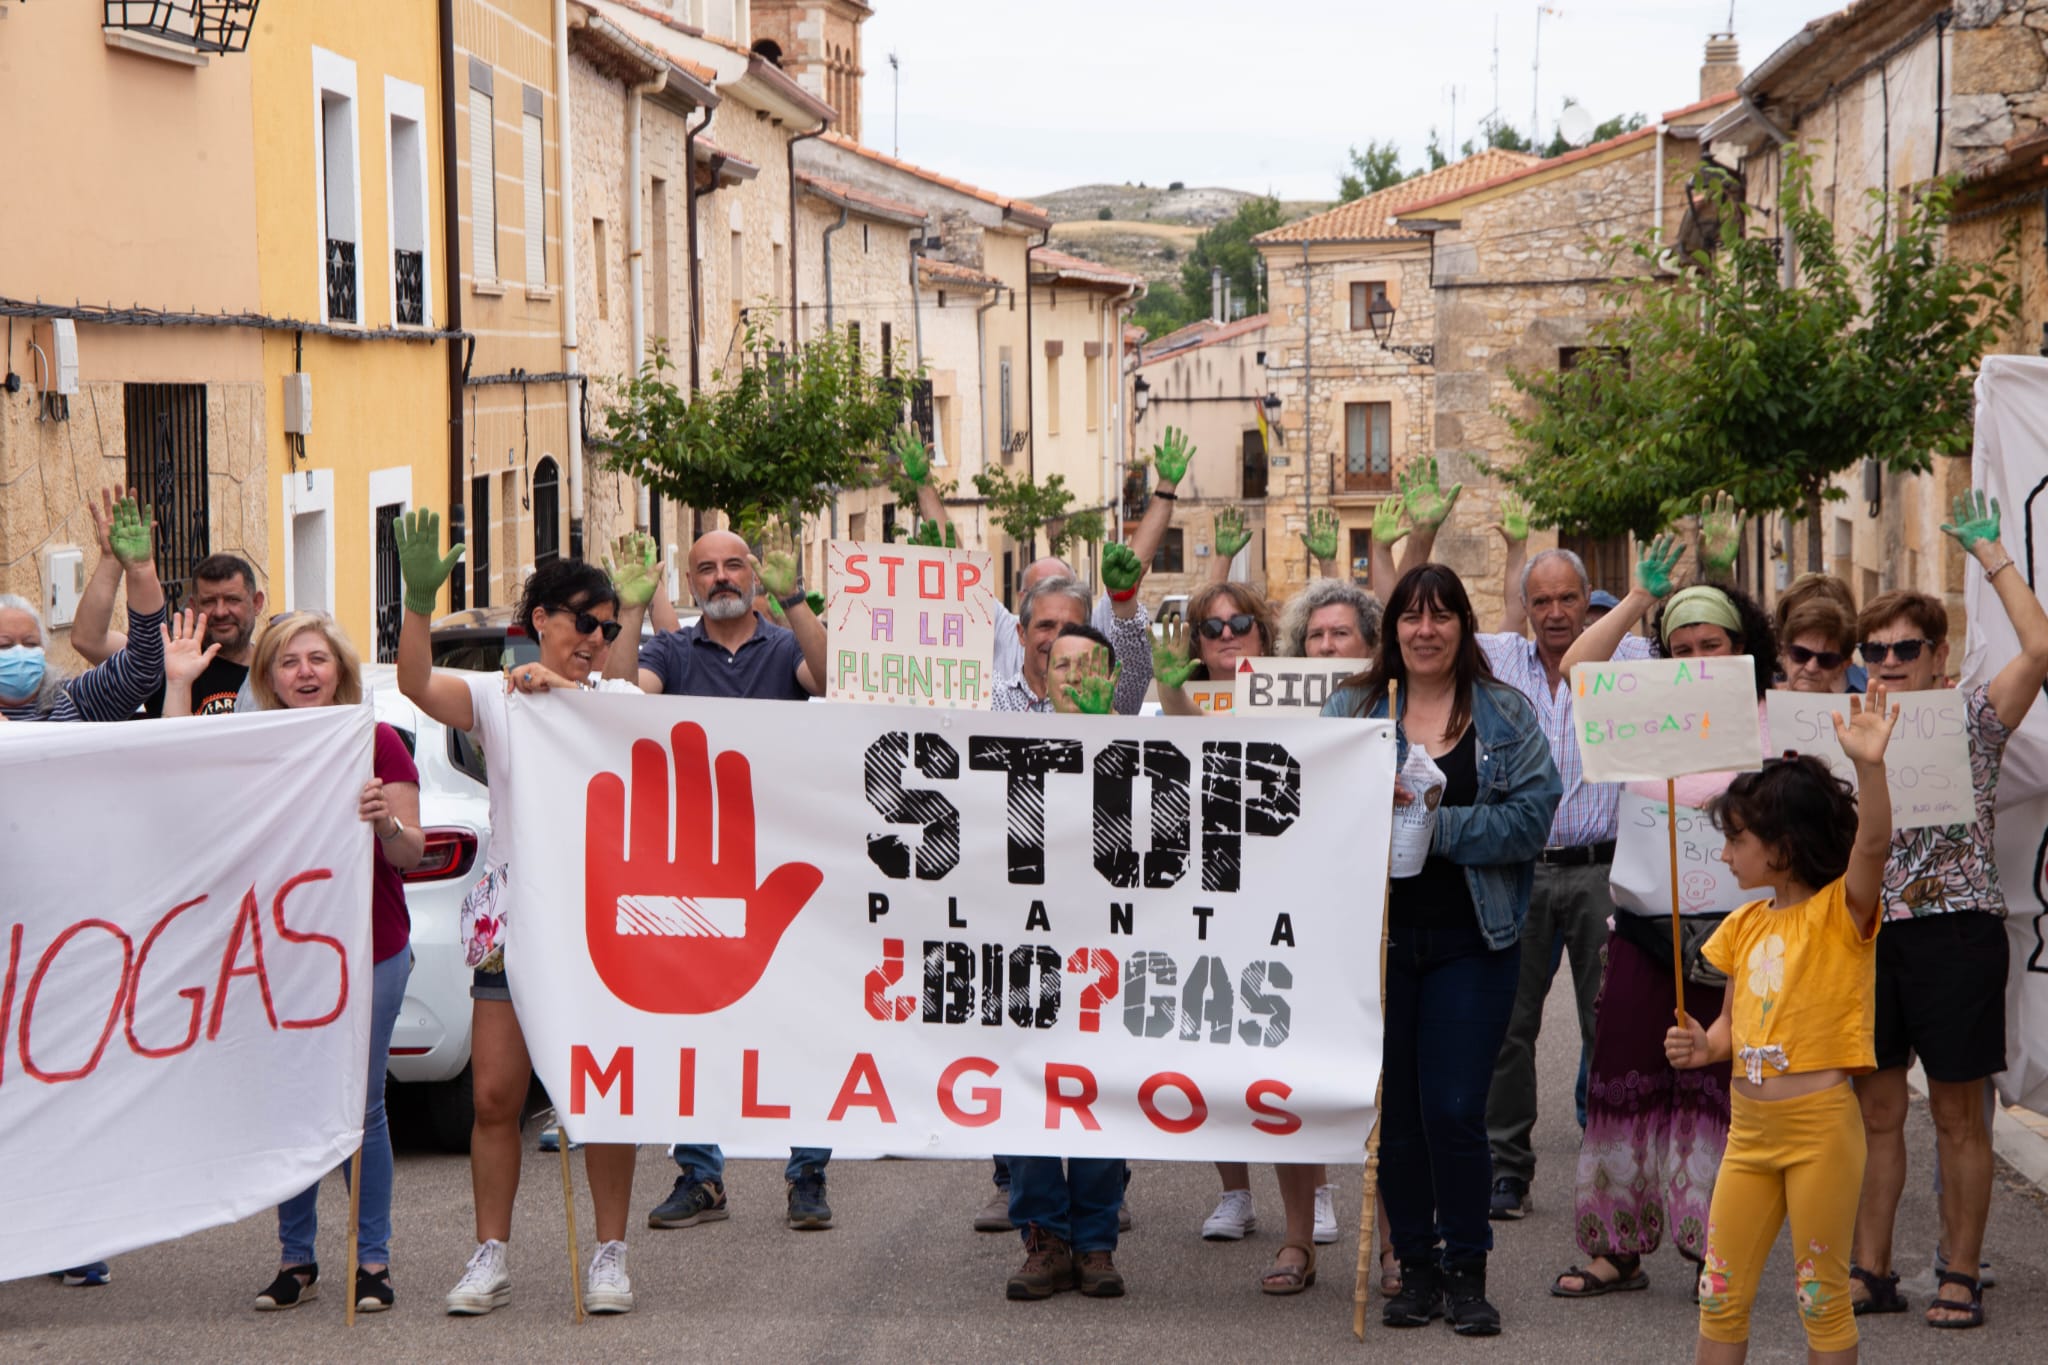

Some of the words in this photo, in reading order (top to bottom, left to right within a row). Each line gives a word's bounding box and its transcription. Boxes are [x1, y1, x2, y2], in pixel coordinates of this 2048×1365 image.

[844, 554, 982, 602] STOP
[871, 607, 894, 642] A
[919, 611, 964, 647] LA
[838, 649, 981, 701] PLANTA
[1673, 660, 1714, 686] AL
[864, 731, 1301, 893] STOP
[868, 892, 1296, 947] PLANTA
[570, 1044, 1303, 1136] MILAGROS
